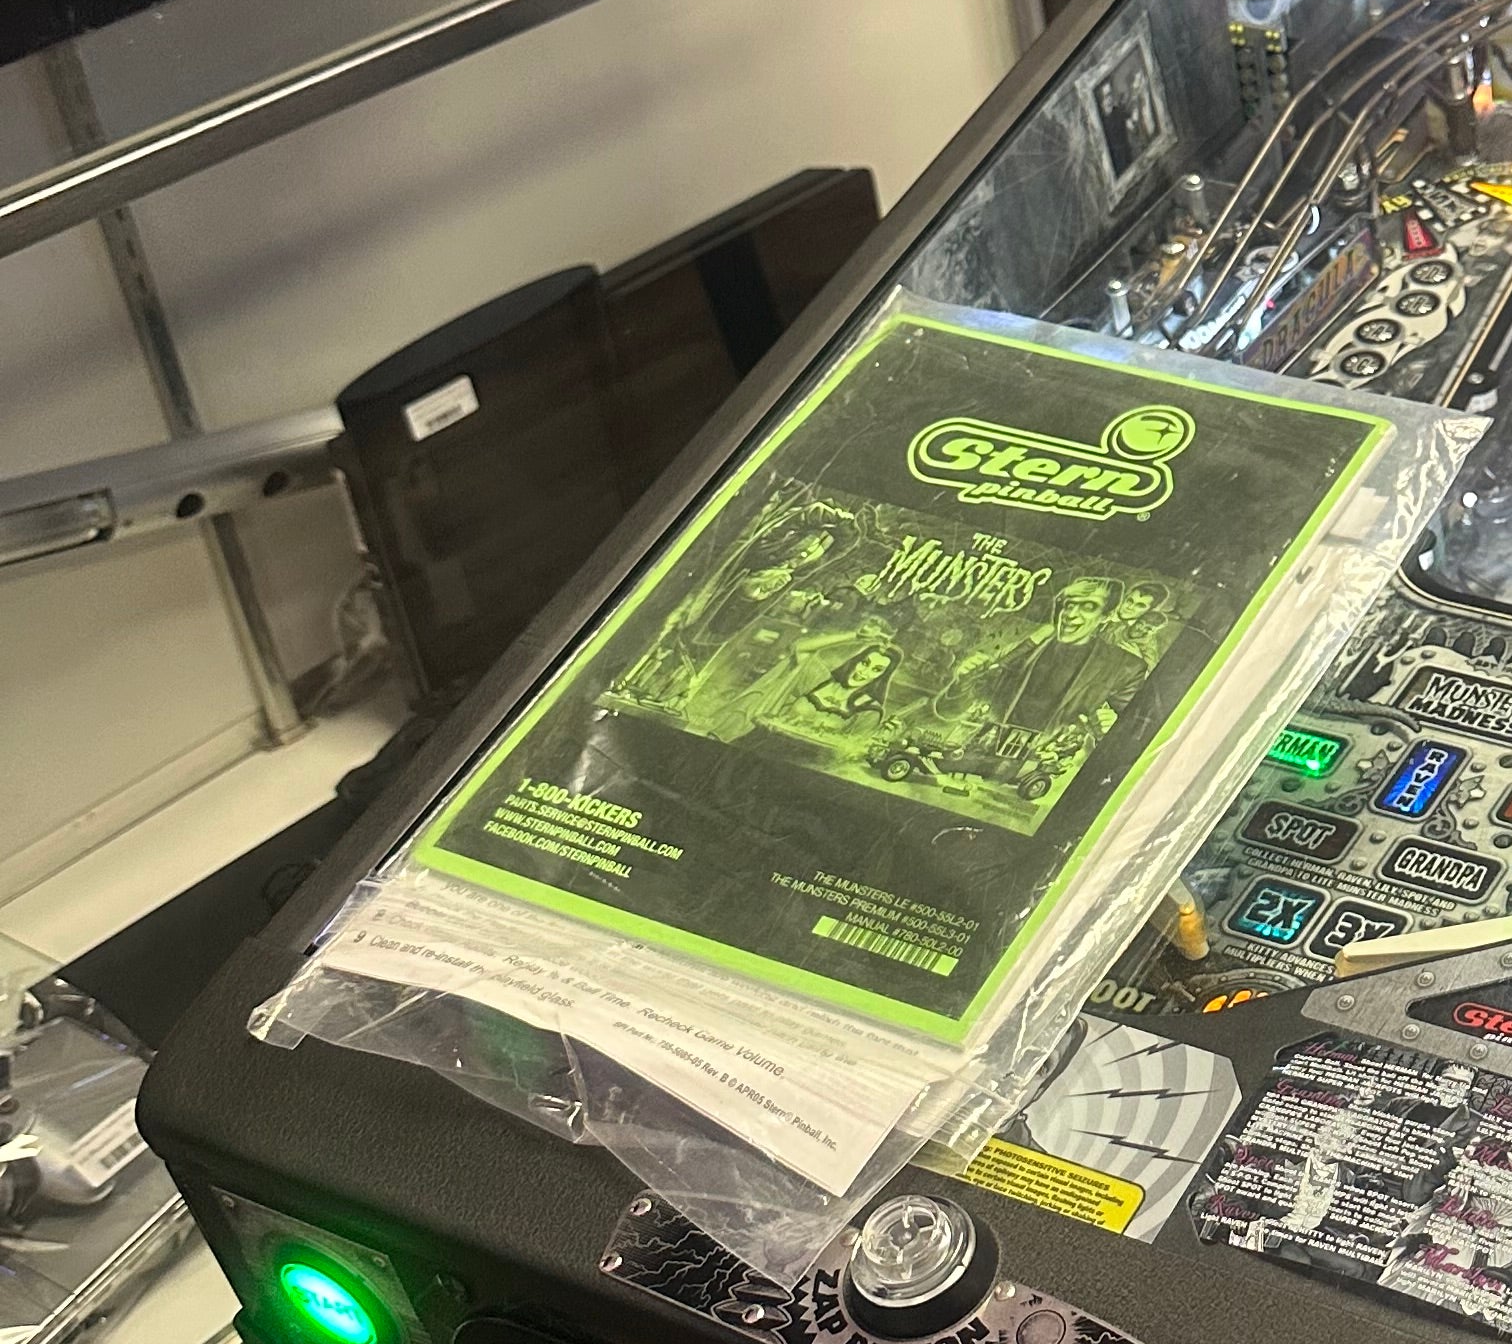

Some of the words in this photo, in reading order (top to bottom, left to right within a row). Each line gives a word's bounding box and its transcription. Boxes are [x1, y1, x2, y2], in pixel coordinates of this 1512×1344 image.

[943, 438, 1141, 497] Stern
[972, 481, 1114, 512] pinball
[972, 532, 1008, 555] THE
[868, 535, 1053, 619] MUNSTERS
[1273, 733, 1340, 763] RMAN
[1394, 748, 1449, 812] RAVEN
[517, 777, 643, 829] 1-800-KICKERS
[484, 821, 633, 878] FACEBOOK.COM/STERNPINBALL
[494, 808, 621, 857] WWW.STERNPINBALL.COM
[504, 794, 684, 861] PARTS.SERVICE@STERNPINBALL.COM
[1265, 812, 1337, 850] SPOT
[1245, 847, 1289, 864] COLLECT
[1394, 847, 1488, 892] GRANDPA
[770, 872, 791, 887] THE
[793, 879, 849, 905] MUNSTERS
[850, 898, 901, 921] PREMIUM
[813, 870, 836, 887] THE
[836, 877, 894, 904] MUNSTERS
[894, 897, 910, 909] LE
[1244, 888, 1317, 932] 2X
[1248, 859, 1295, 877] GRANDPA
[1313, 875, 1336, 888] LITE
[1337, 882, 1387, 902] MUNSTER
[1389, 894, 1441, 917] MADNESS
[846, 912, 891, 934] MANUAL
[354, 930, 367, 944] 9
[370, 934, 401, 953] Clean
[400, 940, 421, 956] and
[421, 947, 472, 975] re-install
[1223, 945, 1292, 973] MULTIPLIERS
[1294, 965, 1328, 983] WHEN
[1248, 943, 1279, 958] KITTY
[1280, 951, 1336, 974] ADVANCES
[1092, 978, 1157, 1013] OOT
[636, 1007, 693, 1035] Recheck
[693, 1027, 735, 1052] Game
[991, 1147, 1067, 1176] PHOTOSENSITIVE
[1066, 1171, 1111, 1191] SEIZURES
[812, 1269, 848, 1336] ZAP
